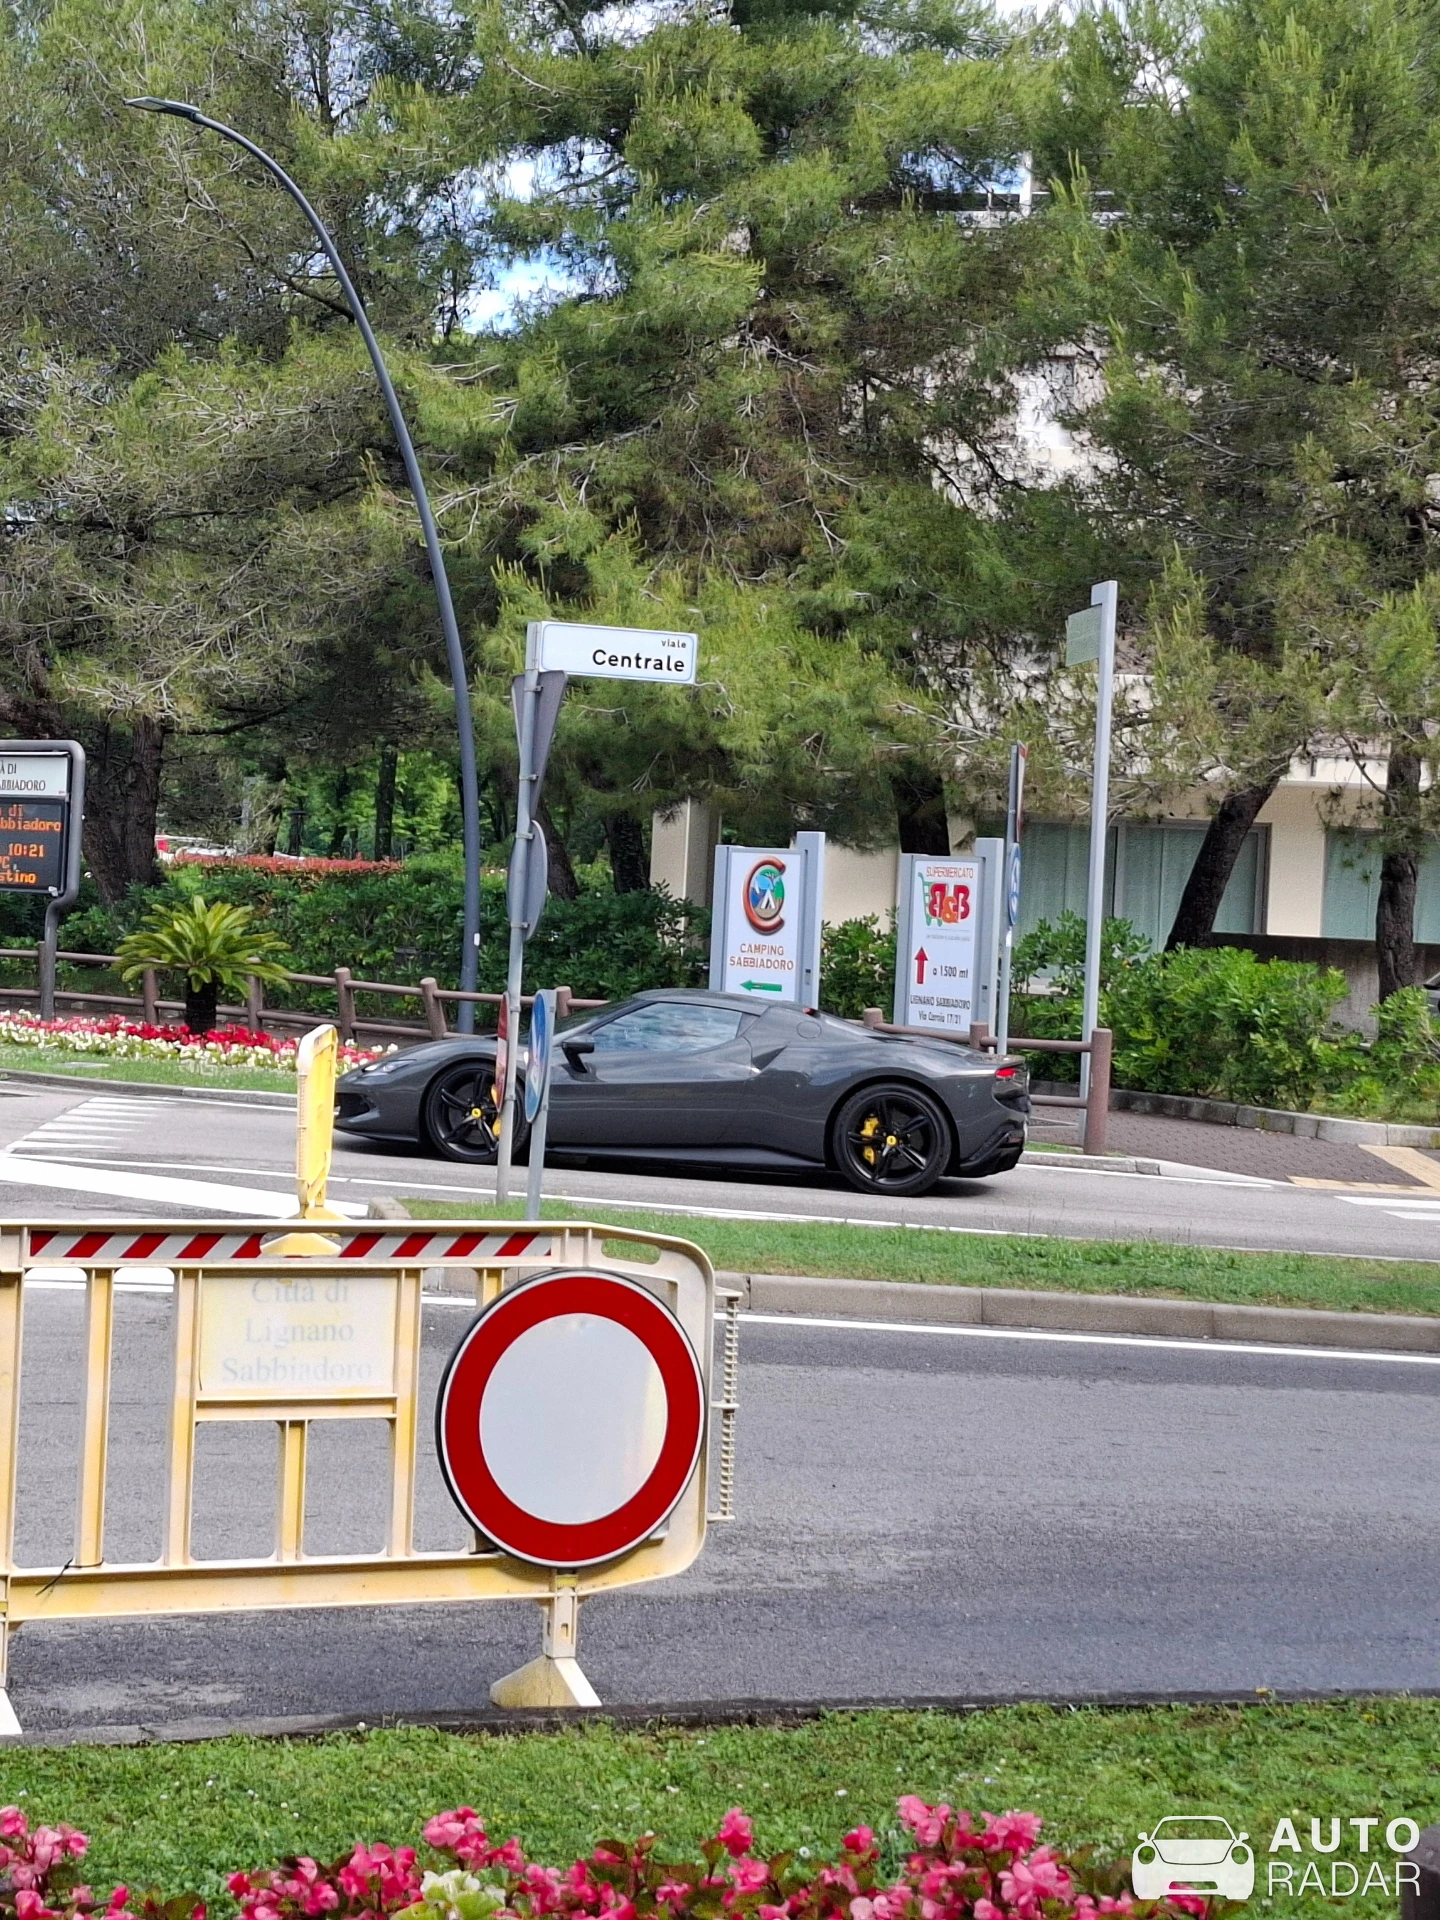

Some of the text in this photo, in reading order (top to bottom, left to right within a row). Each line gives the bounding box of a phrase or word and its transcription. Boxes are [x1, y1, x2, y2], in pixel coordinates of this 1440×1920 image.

[661, 639, 687, 648] viale
[592, 649, 685, 672] Centrale
[7, 763, 17, 774] DI
[9, 804, 23, 816] di
[8, 843, 44, 857] 10:21
[926, 866, 974, 879] SUPERMERCATO
[740, 943, 784, 956] CAMPING
[729, 956, 794, 971] SABBIADORO
[918, 1010, 927, 1020] Via
[252, 1277, 349, 1303] Città di
[246, 1317, 355, 1348] Lignano
[222, 1357, 373, 1382] Sabbiadoro
